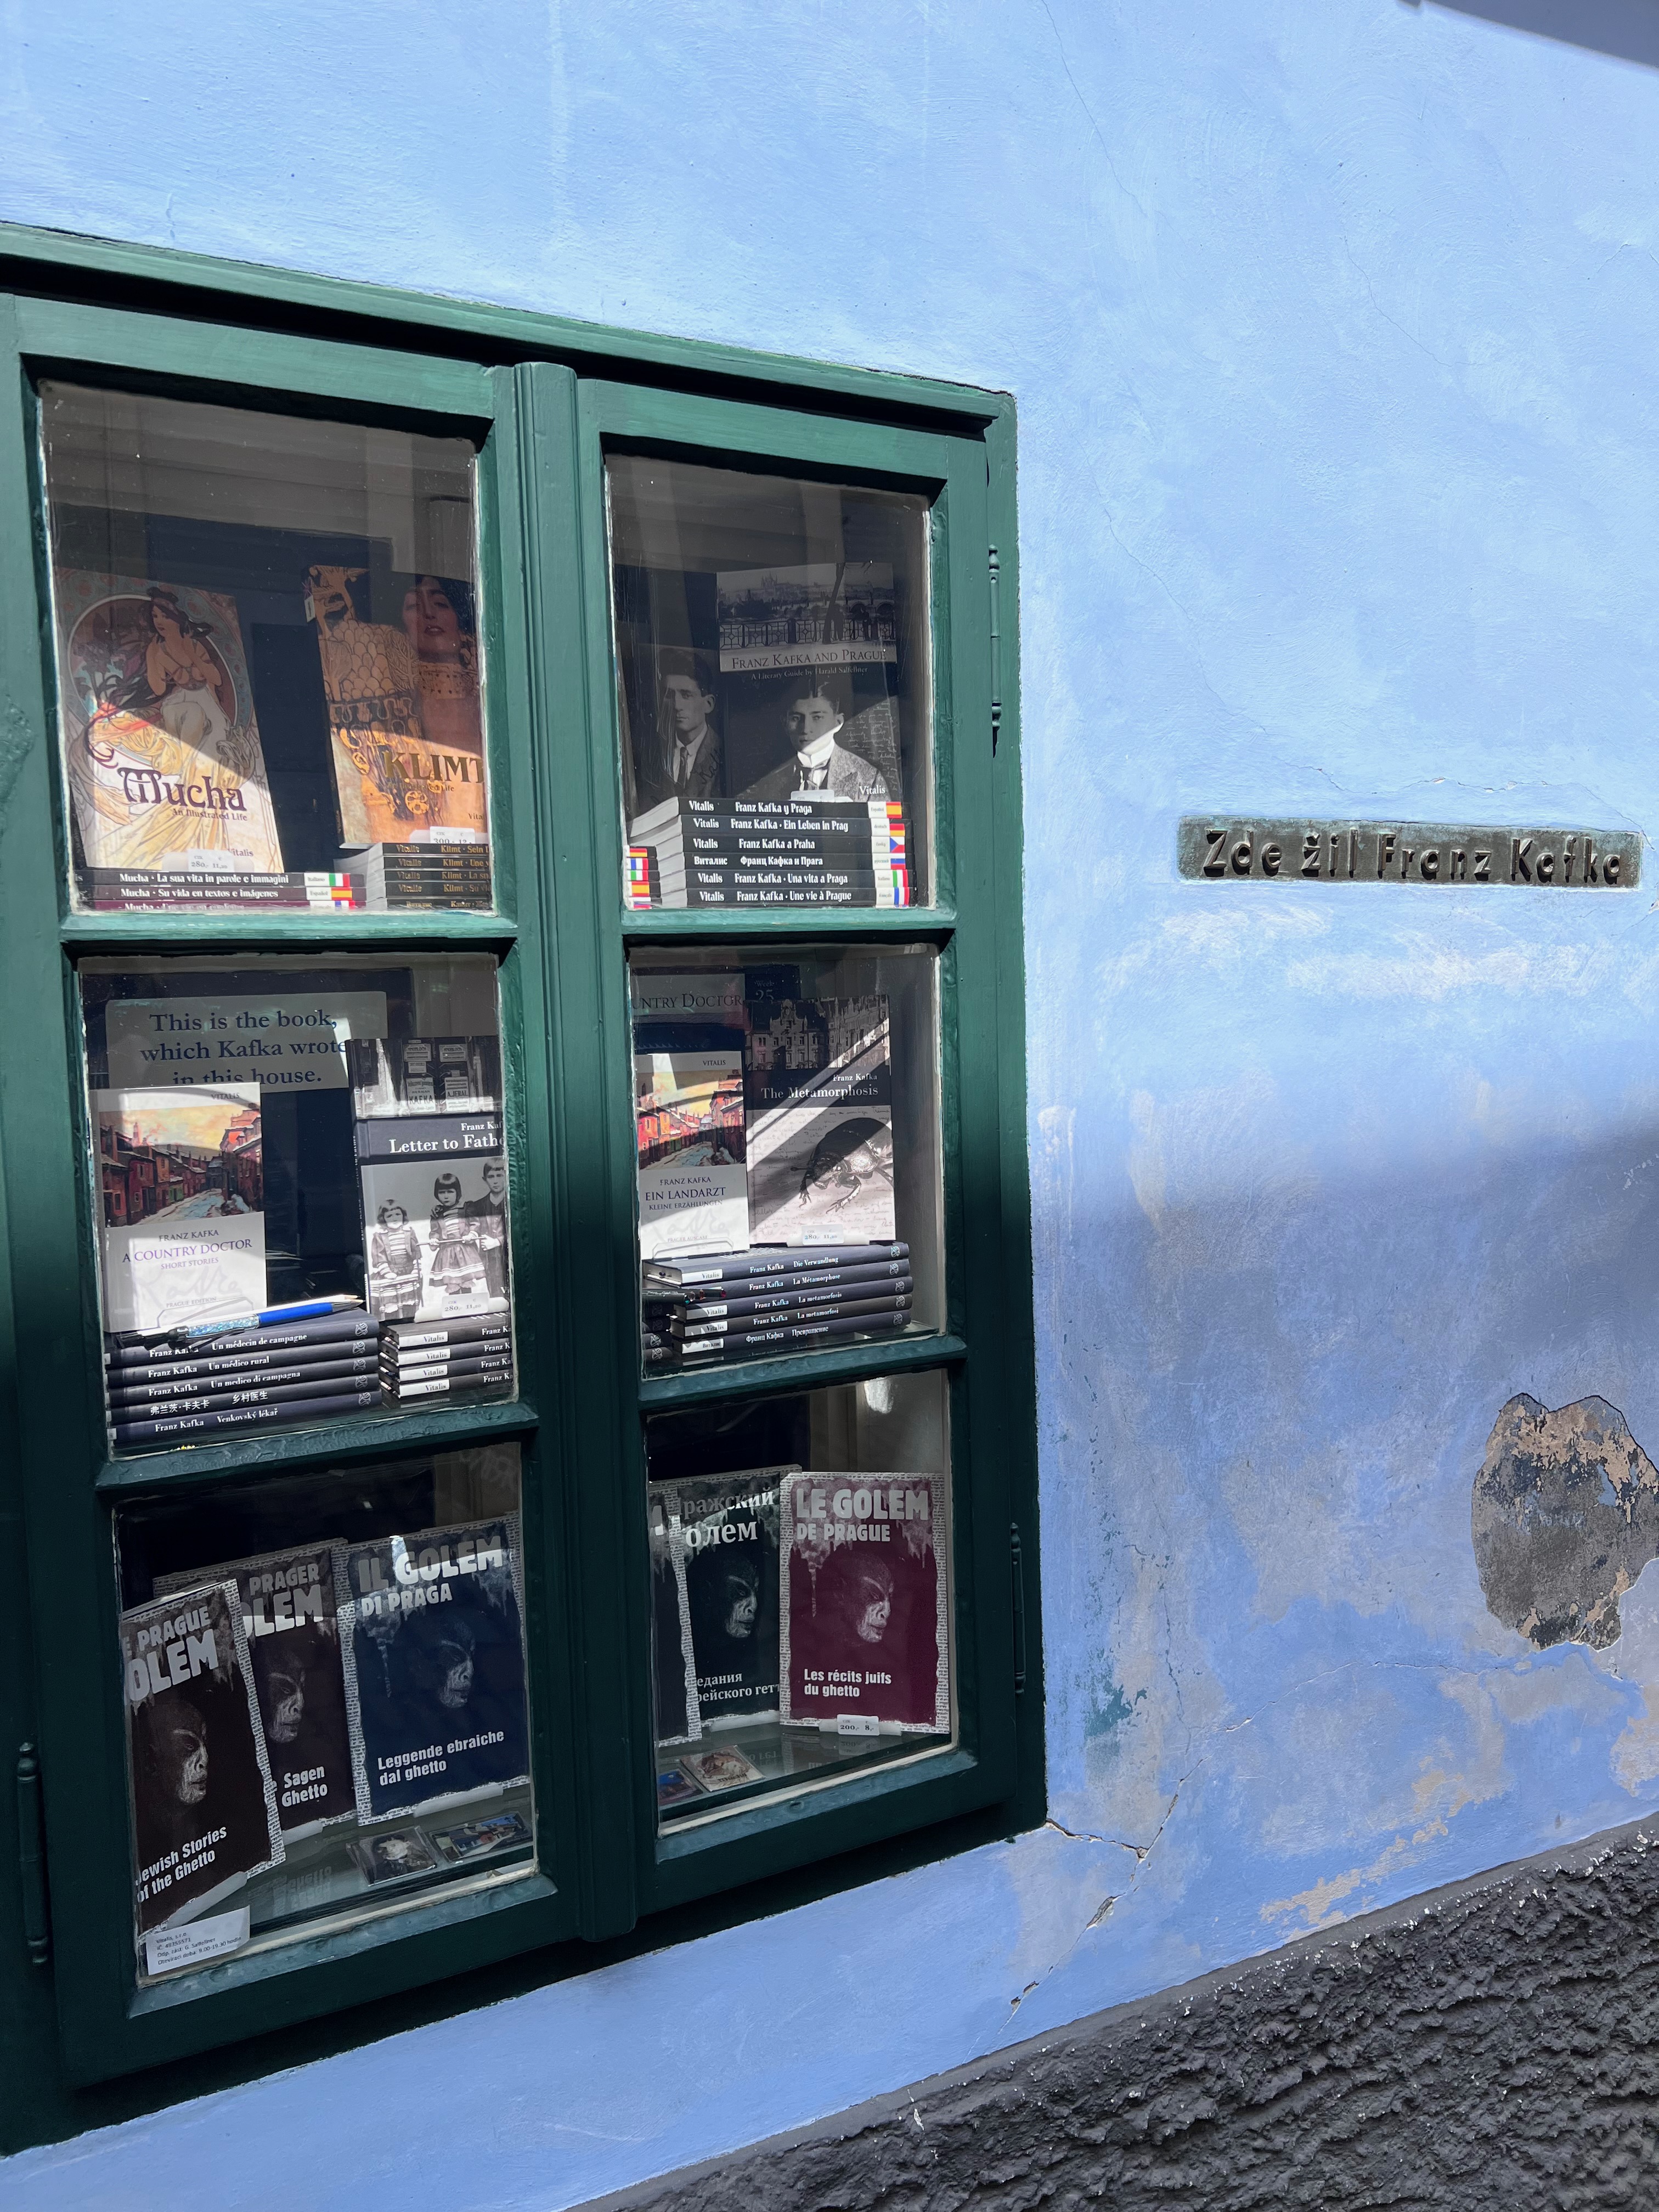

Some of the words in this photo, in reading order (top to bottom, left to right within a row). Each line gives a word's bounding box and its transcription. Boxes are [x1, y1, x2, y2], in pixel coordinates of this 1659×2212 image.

[732, 657, 769, 669] FRANZ
[773, 653, 810, 665] KAFKA
[815, 652, 838, 663] AND
[842, 649, 887, 661] PRAGUE
[758, 672, 782, 680] Literary
[815, 667, 837, 675] Harald
[382, 751, 484, 783] KLIMT
[117, 767, 247, 811] Mucha
[859, 786, 886, 795] Vitalis
[689, 800, 714, 811] Vitalis
[735, 802, 757, 812] Franz
[758, 802, 782, 813] Kafka
[791, 804, 812, 815] Praga
[232, 812, 247, 821] Life
[693, 818, 719, 828] Vitalis
[731, 818, 752, 829] Franz
[754, 819, 778, 830] Kafka
[798, 820, 821, 830] Leben
[831, 820, 849, 832] Prag
[441, 845, 461, 853] Klimt
[693, 838, 718, 849] Vitalis
[739, 838, 760, 849] Franz
[762, 838, 785, 849] Kafka
[794, 839, 815, 849] Praha
[443, 859, 463, 867] Klimt
[694, 856, 728, 865] Виталис
[741, 856, 767, 867] Франц
[768, 856, 793, 867] Кафка
[801, 856, 823, 867] Прага
[1203, 829, 1283, 878] Zde
[1301, 827, 1359, 877] žil
[1377, 832, 1492, 879] Franz
[1510, 836, 1622, 884] Kafka
[119, 873, 149, 883] Mucha
[186, 873, 203, 883] vita
[216, 873, 241, 885] parole
[251, 874, 289, 885] immagini
[442, 871, 462, 879] Klimt
[698, 872, 723, 883] Vitalis
[735, 873, 757, 883] Franz
[758, 873, 782, 883] Kafka
[827, 873, 848, 885] Praga
[121, 888, 150, 898] Mucha
[205, 889, 230, 898] textos
[239, 889, 279, 899] imágenes
[443, 884, 464, 893] Klimt
[699, 891, 725, 901] Vitalis
[737, 891, 758, 901] Franz
[760, 891, 783, 901] Kafka
[826, 890, 851, 902] Prague
[682, 994, 743, 1008] DOCTOR
[149, 1013, 202, 1031] This
[210, 1012, 228, 1030] is
[235, 1011, 270, 1029] the
[276, 1009, 337, 1030] book,
[140, 1042, 211, 1062] which
[218, 1039, 283, 1058] Kafka
[289, 1040, 346, 1055] wrote
[202, 1069, 244, 1084] this
[251, 1068, 321, 1085] house.
[833, 1074, 854, 1082] Franz
[855, 1073, 878, 1081] Kafka
[211, 1092, 240, 1101] VITALIS
[760, 1087, 784, 1099] The
[788, 1084, 878, 1101] Metamorphosis
[461, 1122, 485, 1131] Franz
[388, 1138, 438, 1154] Letter
[442, 1138, 459, 1149] to
[660, 1178, 685, 1186] FRANZ
[687, 1176, 712, 1184] KAFKA
[645, 1191, 664, 1201] EIN
[668, 1187, 726, 1200] LANDARZT
[674, 1199, 723, 1209] ERZÄHLUNGEN
[159, 1232, 189, 1242] FRANZ
[191, 1229, 219, 1239] KAFKA
[134, 1245, 198, 1261] COUNTRY
[200, 1239, 253, 1255] DOCTOR
[161, 1261, 187, 1270] SHORT
[189, 1257, 219, 1267] STORIES
[767, 1263, 785, 1271] Kafka
[804, 1256, 839, 1266] Verwandlung
[766, 1280, 783, 1289] Kafka
[802, 1273, 841, 1284] Métamorphose
[166, 1300, 190, 1308] PRAGUE
[191, 1296, 217, 1305] EDITION
[772, 1299, 789, 1307] Kafka
[807, 1291, 842, 1302] metamorfosis
[771, 1314, 788, 1323] Kafka
[806, 1307, 839, 1318] metamorfosi
[424, 1335, 445, 1343] Vitalis
[766, 1331, 785, 1340] Кафка
[149, 1349, 173, 1358] Franz
[225, 1339, 257, 1350] médecin
[269, 1334, 307, 1344] campagne
[148, 1369, 171, 1378] Franz
[173, 1365, 198, 1375] Kafka
[222, 1359, 249, 1368] médico
[251, 1356, 270, 1365] rural
[149, 1388, 171, 1396] Franz
[173, 1384, 198, 1393] Kafka
[224, 1377, 252, 1386] medico
[262, 1372, 301, 1382] campagna
[425, 1383, 447, 1391] Vitalis
[232, 1390, 268, 1404] 乡村医生
[155, 1424, 178, 1432] Franz
[180, 1419, 204, 1429] Kafka
[217, 1410, 257, 1423] Venkovský
[259, 1408, 278, 1418] lékař
[678, 1487, 774, 1520] ражский
[797, 1488, 826, 1518] LE
[833, 1489, 928, 1520] GOLEM
[686, 1521, 758, 1548] олем
[797, 1523, 816, 1540] DE
[824, 1523, 890, 1542] PRAGUE
[358, 1557, 388, 1593] IL
[394, 1535, 504, 1585] GOLEM
[249, 1563, 320, 1596] PRAGER
[361, 1595, 382, 1617] DI
[388, 1583, 453, 1612] PRAGA
[240, 1584, 324, 1639] OLEM
[137, 1605, 211, 1652] PRAGUE
[128, 1628, 219, 1702] OLEM
[697, 1673, 743, 1687] едания
[804, 1668, 825, 1681] Les
[828, 1669, 862, 1683] récits
[865, 1671, 891, 1685] juifs
[804, 1683, 819, 1695] du
[822, 1684, 860, 1697] ghetto
[377, 1744, 443, 1770] Leggende
[447, 1730, 504, 1754] ebraiche
[284, 1765, 325, 1789] Sagen
[379, 1768, 401, 1787] dal
[405, 1759, 447, 1782] ghetto
[281, 1782, 328, 1808] Ghetto
[136, 1850, 179, 1886] Jewish
[182, 1826, 227, 1859] Stories
[151, 1874, 172, 1895] the
[175, 1850, 216, 1881] Ghetto
